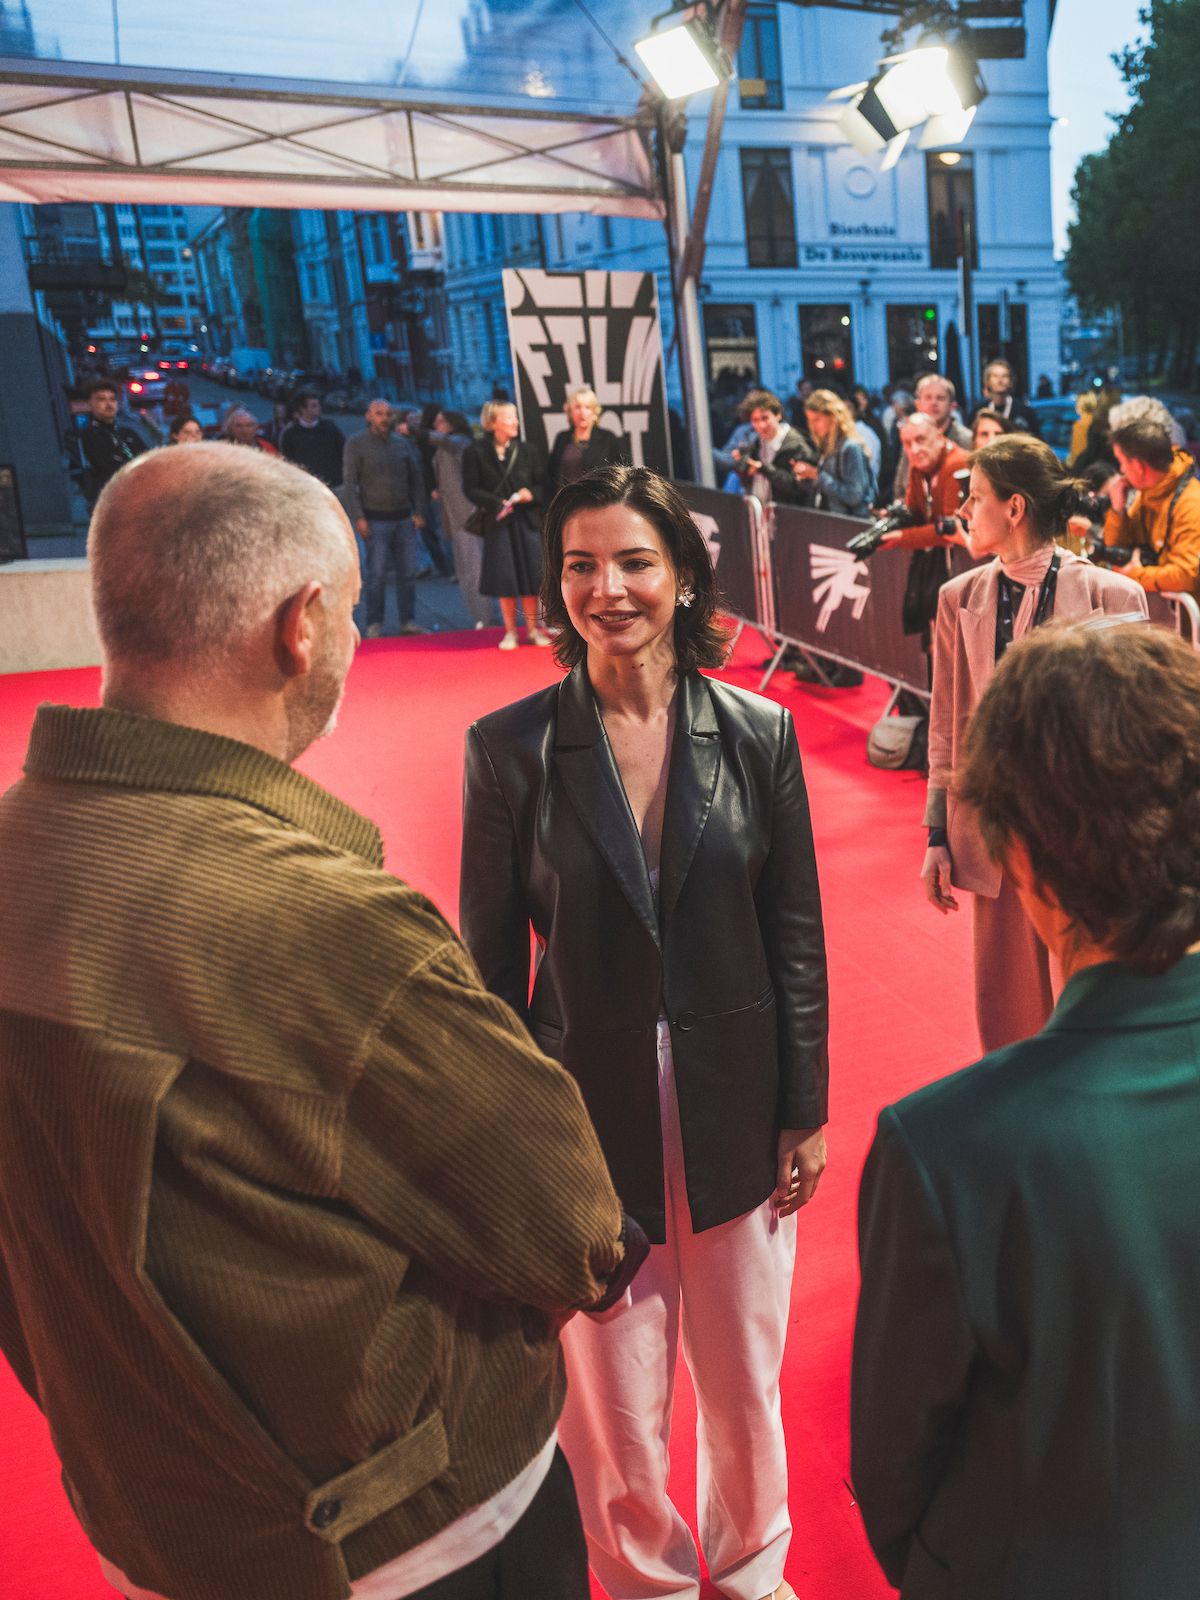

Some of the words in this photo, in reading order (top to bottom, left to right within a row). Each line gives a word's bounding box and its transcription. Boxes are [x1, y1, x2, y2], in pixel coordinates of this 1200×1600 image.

[829, 222, 896, 236] Bierhuis
[804, 246, 826, 261] De
[510, 315, 662, 407] FILM
